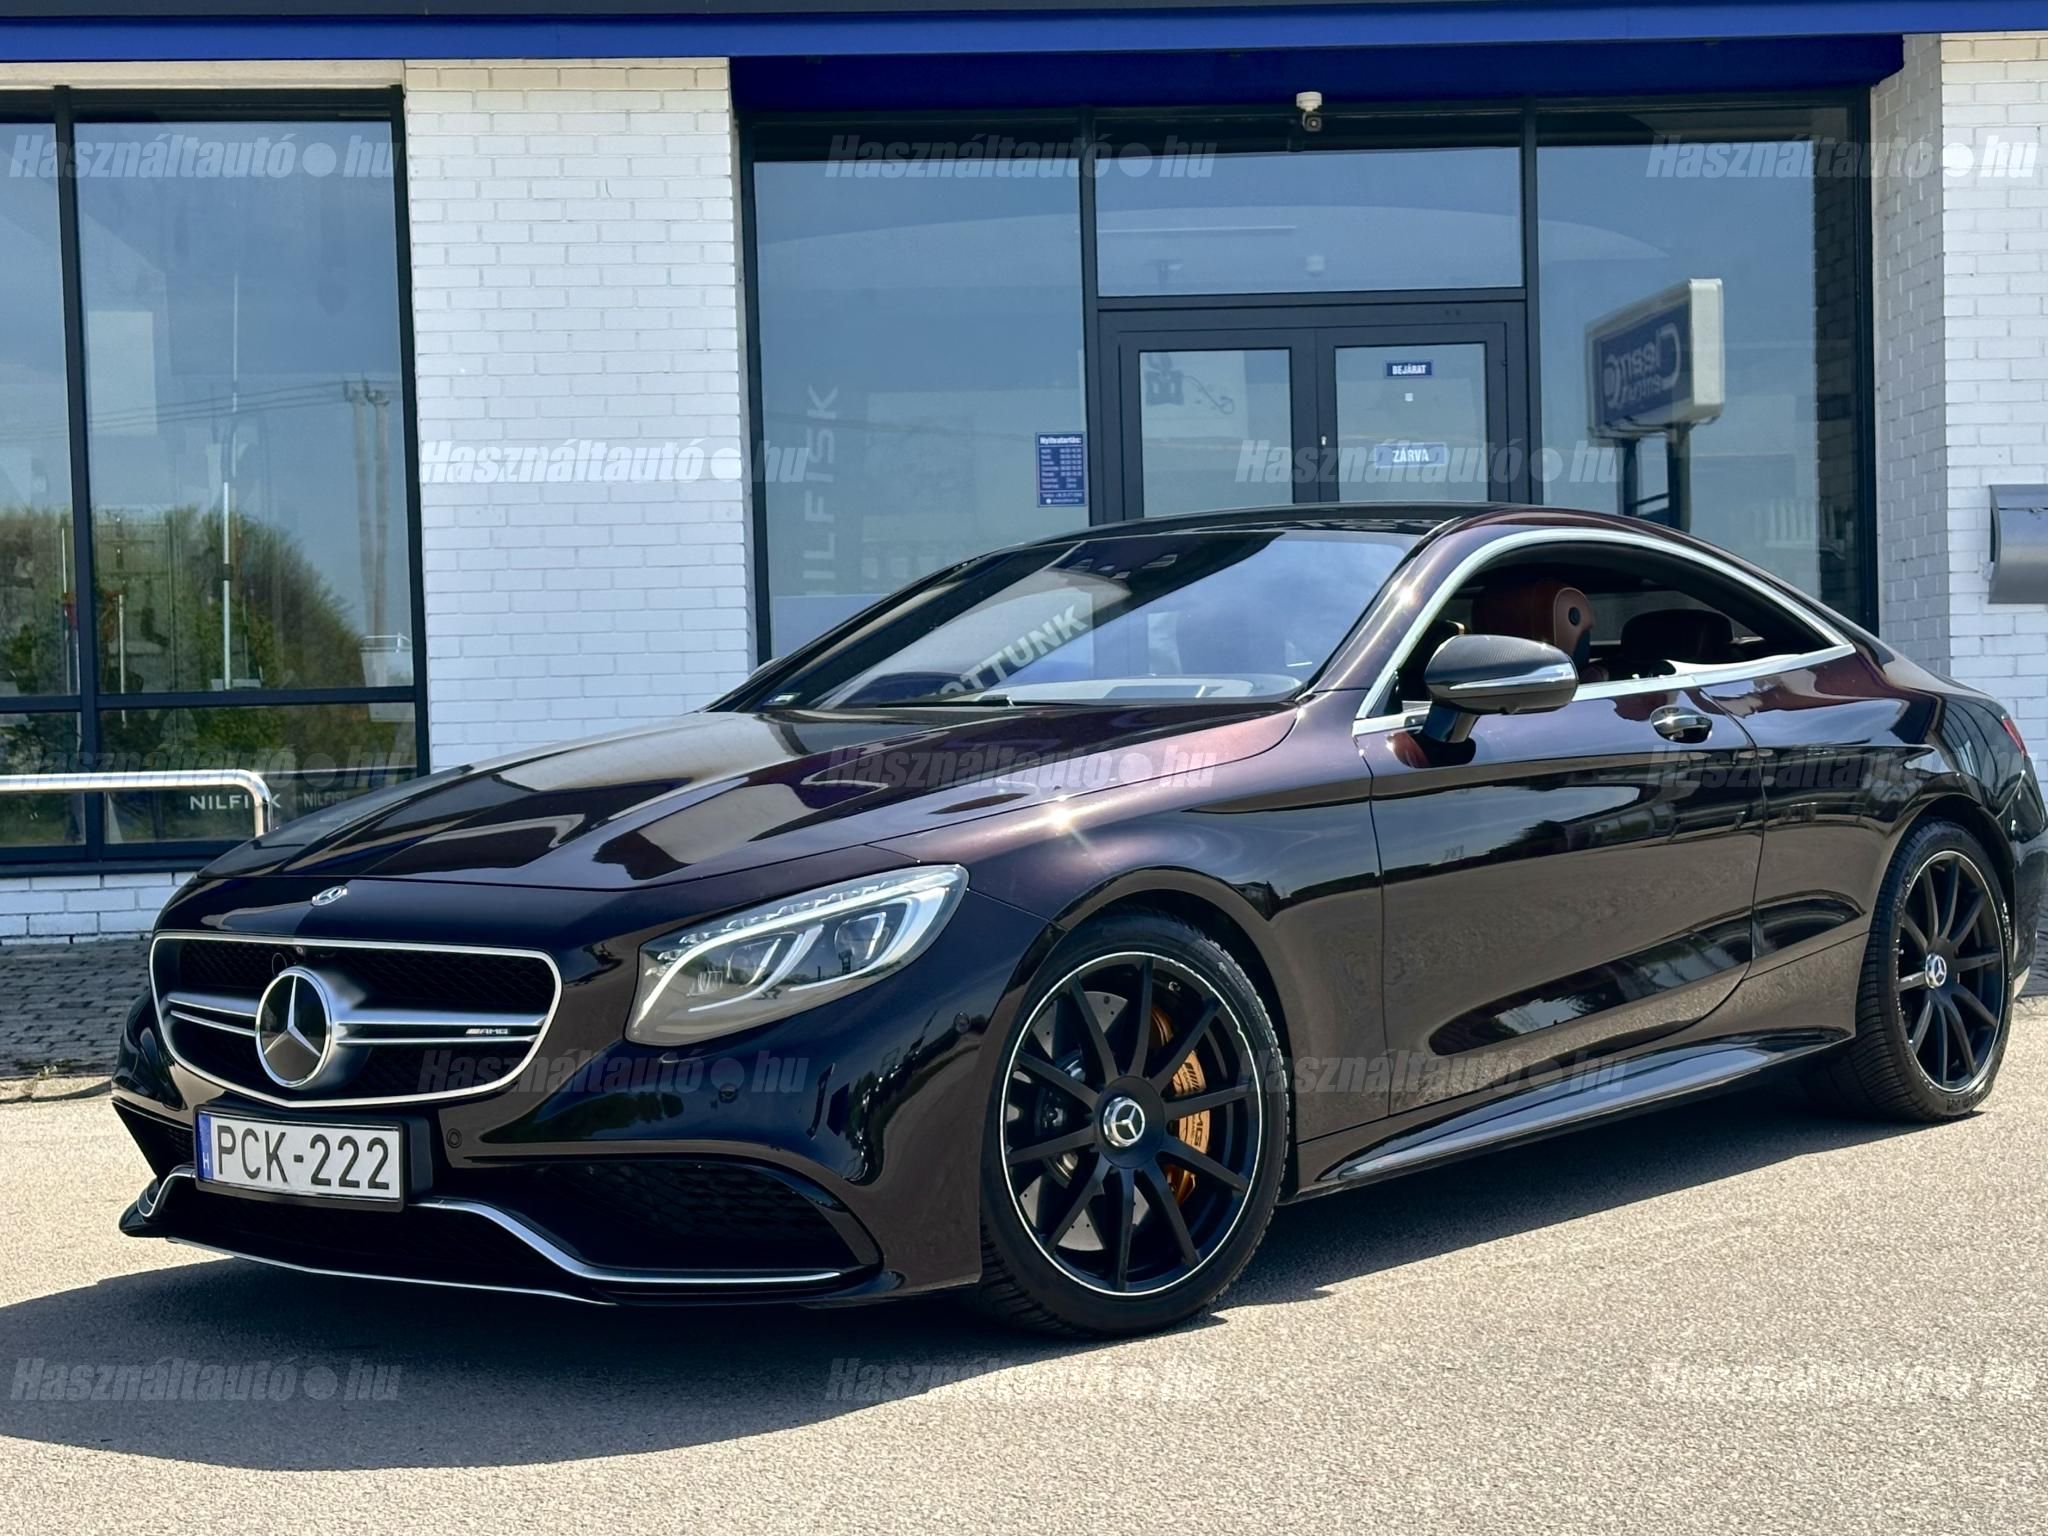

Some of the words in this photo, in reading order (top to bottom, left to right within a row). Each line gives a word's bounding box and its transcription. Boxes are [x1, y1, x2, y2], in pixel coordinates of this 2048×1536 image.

[1391, 363, 1427, 376] BEJÁRAT
[1392, 448, 1430, 463] ZÁRVA
[803, 385, 839, 596] ILFISK
[189, 793, 282, 811] NILFIK
[202, 1152, 210, 1170] H
[216, 1125, 390, 1190] PCK-222
